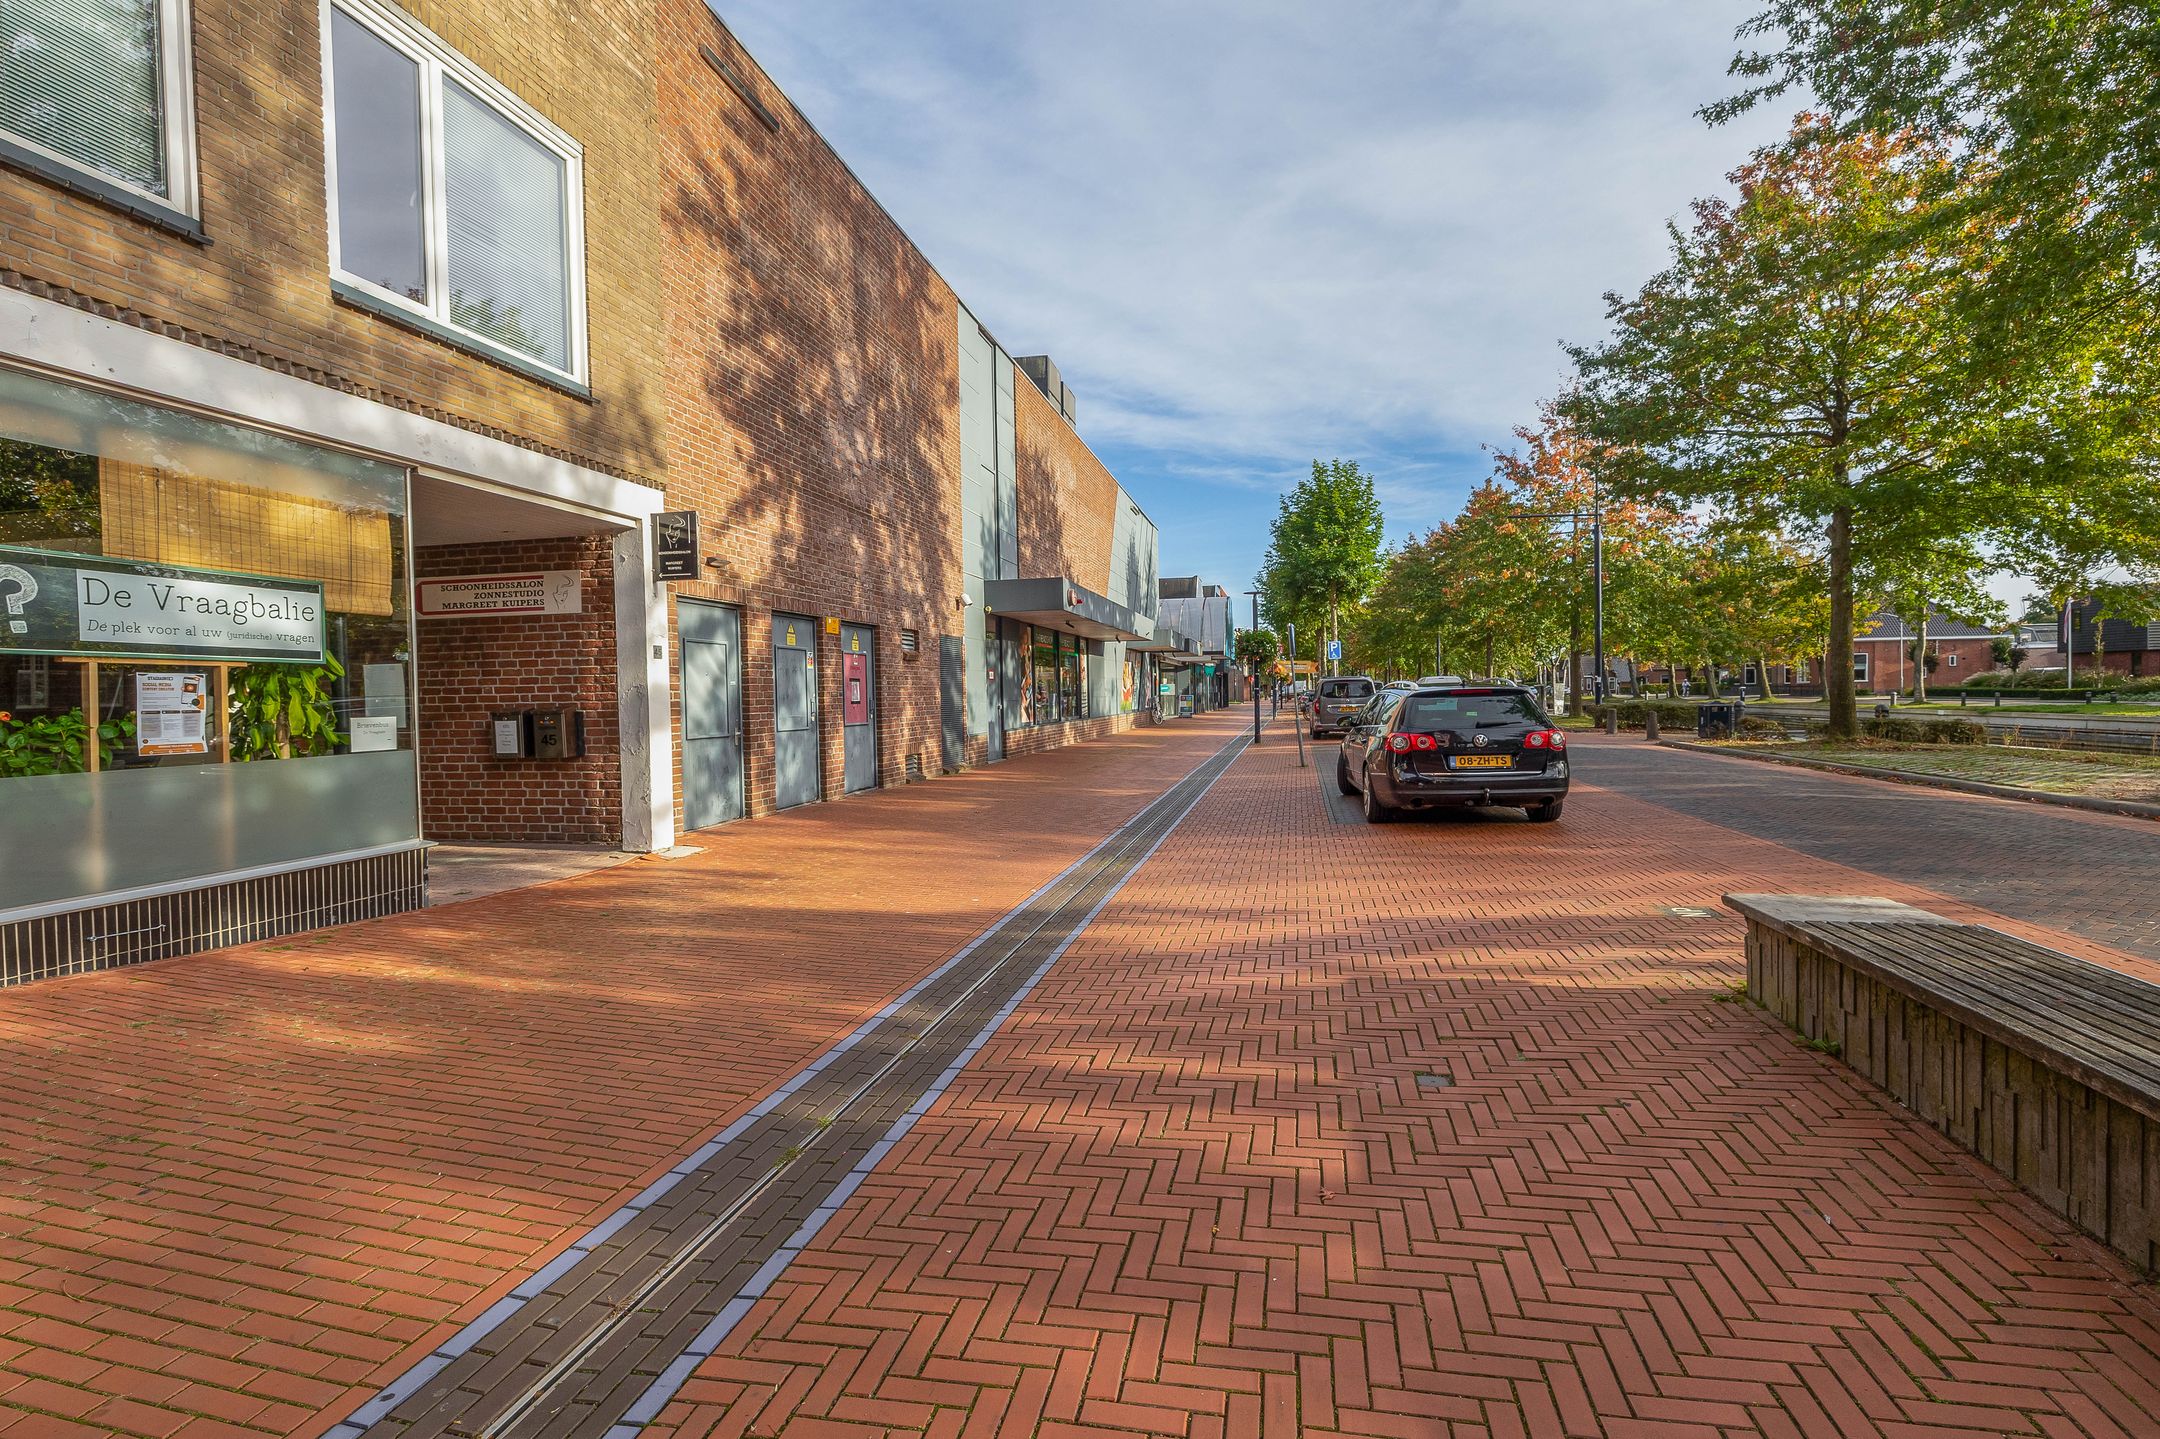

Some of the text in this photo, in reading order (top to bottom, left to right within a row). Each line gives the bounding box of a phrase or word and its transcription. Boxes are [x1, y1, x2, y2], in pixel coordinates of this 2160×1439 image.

[440, 580, 544, 592] SCHOONHEIDSSALON
[473, 589, 545, 600] ZONNESTUDIO
[82, 577, 315, 625] De Vraagbalie
[442, 598, 545, 610] MARGREET KUIPERS
[87, 619, 315, 645] De plek voor al uw (juridische) vragen
[1330, 642, 1338, 652] P
[541, 734, 557, 746] 45
[1459, 756, 1507, 766] 08-ZH-TS
